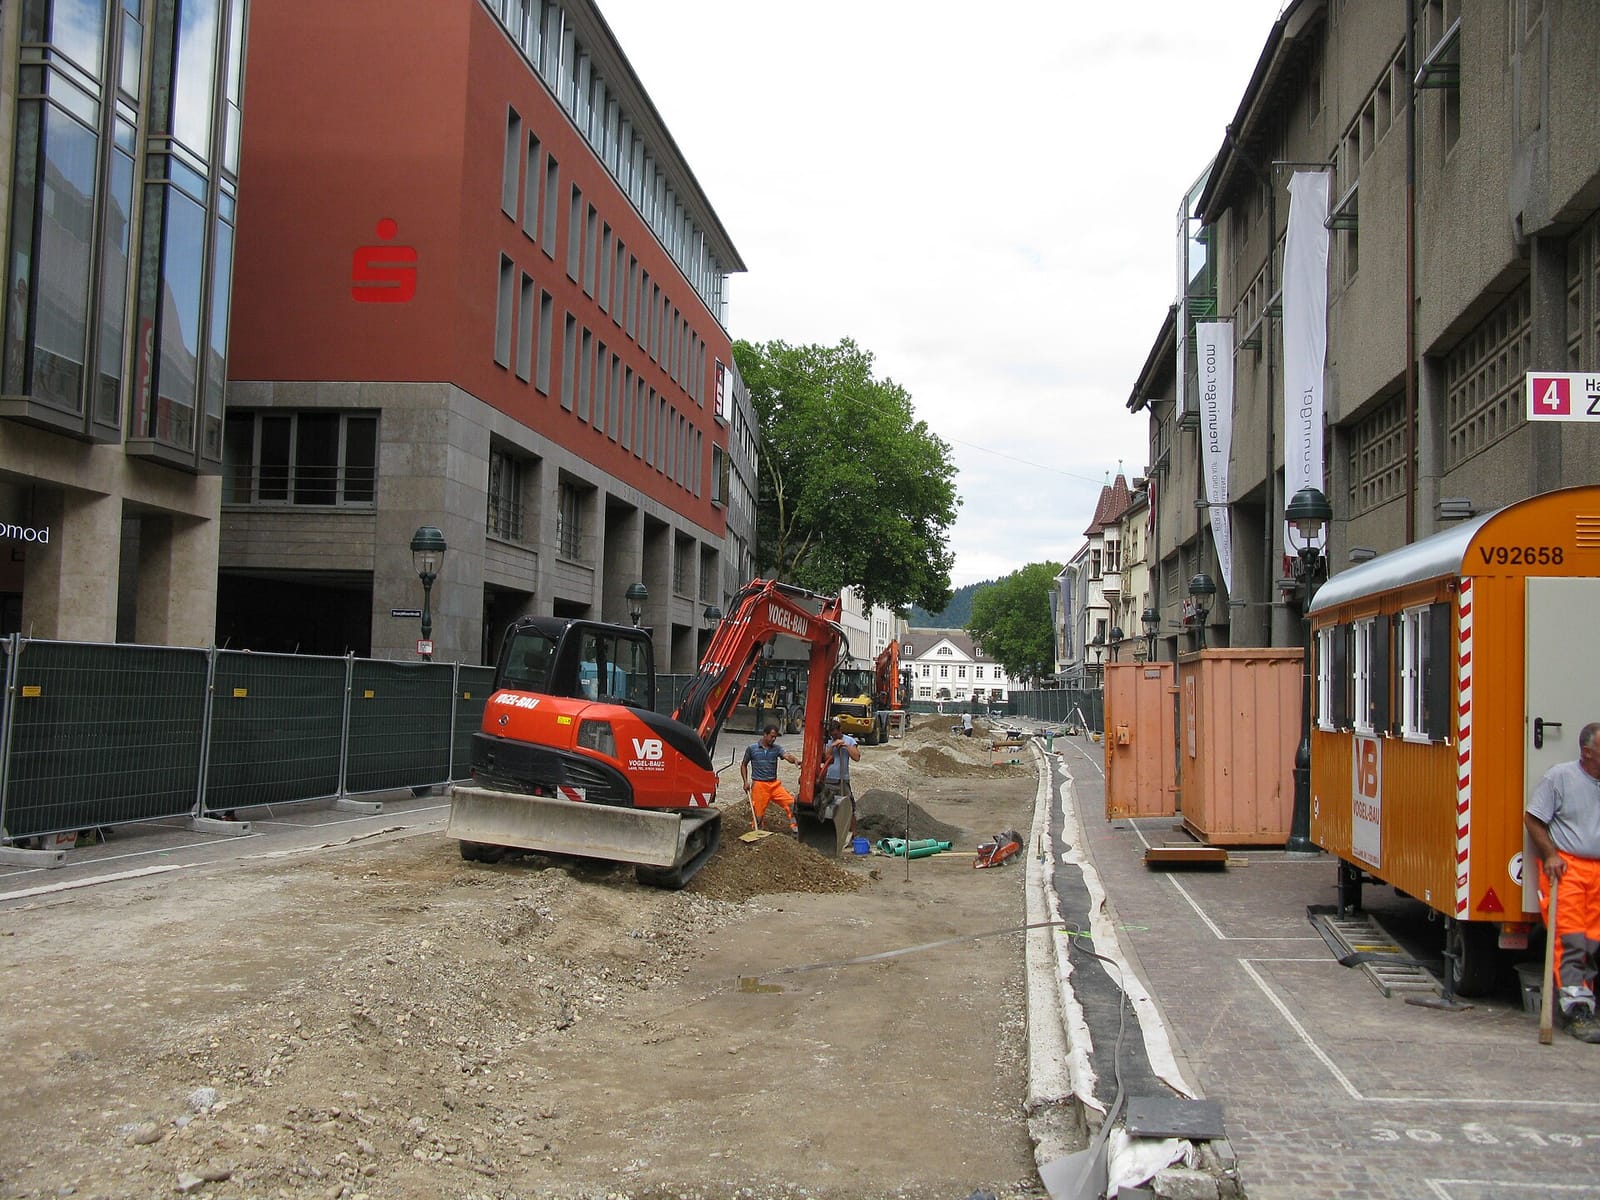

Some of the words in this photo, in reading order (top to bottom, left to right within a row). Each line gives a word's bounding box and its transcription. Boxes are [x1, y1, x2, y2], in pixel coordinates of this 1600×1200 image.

[1542, 380, 1560, 410] 4
[1480, 546, 1564, 565] V92658
[768, 602, 808, 637] VOGEL-BAU
[494, 693, 540, 710] VOGEL-BAU
[631, 738, 663, 760] VB
[1354, 738, 1378, 798] VB
[1353, 799, 1379, 825] VOGEL-BAU
